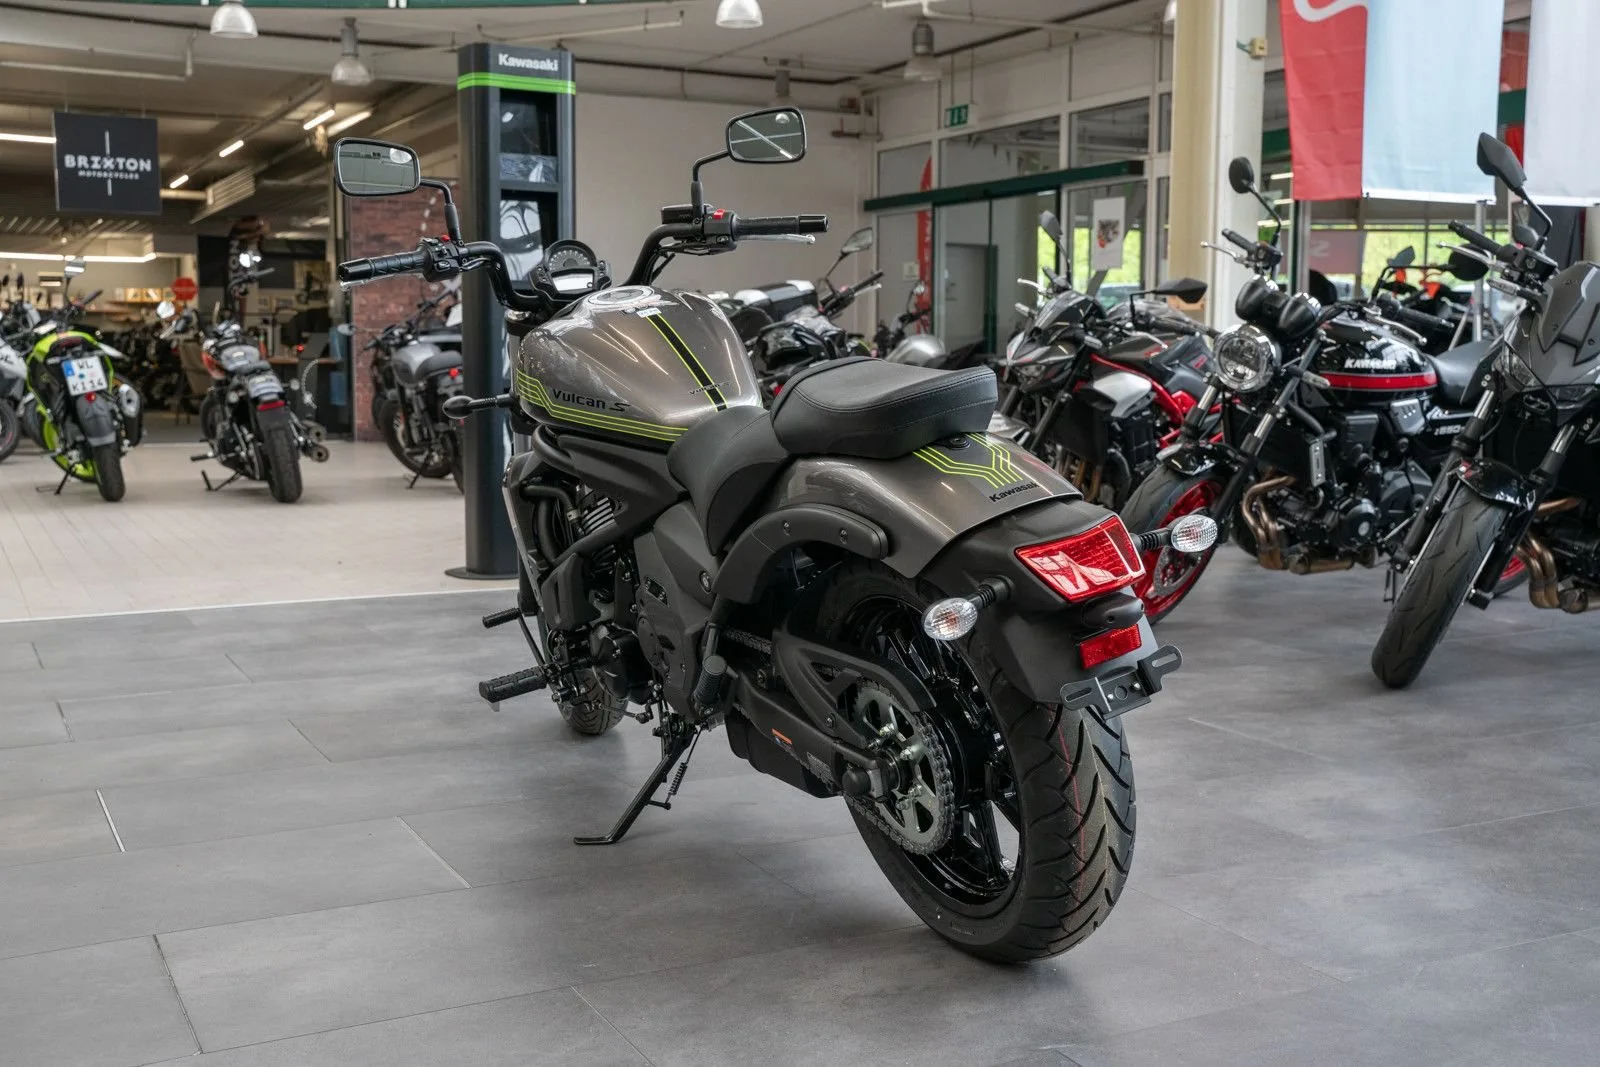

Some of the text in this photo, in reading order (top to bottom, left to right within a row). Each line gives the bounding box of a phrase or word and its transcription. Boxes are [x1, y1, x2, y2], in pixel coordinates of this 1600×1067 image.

[498, 53, 559, 71] Kawasaki
[64, 154, 152, 172] BRIXTON
[553, 388, 631, 412] Vulcan S
[989, 482, 1041, 502] Kawasak
